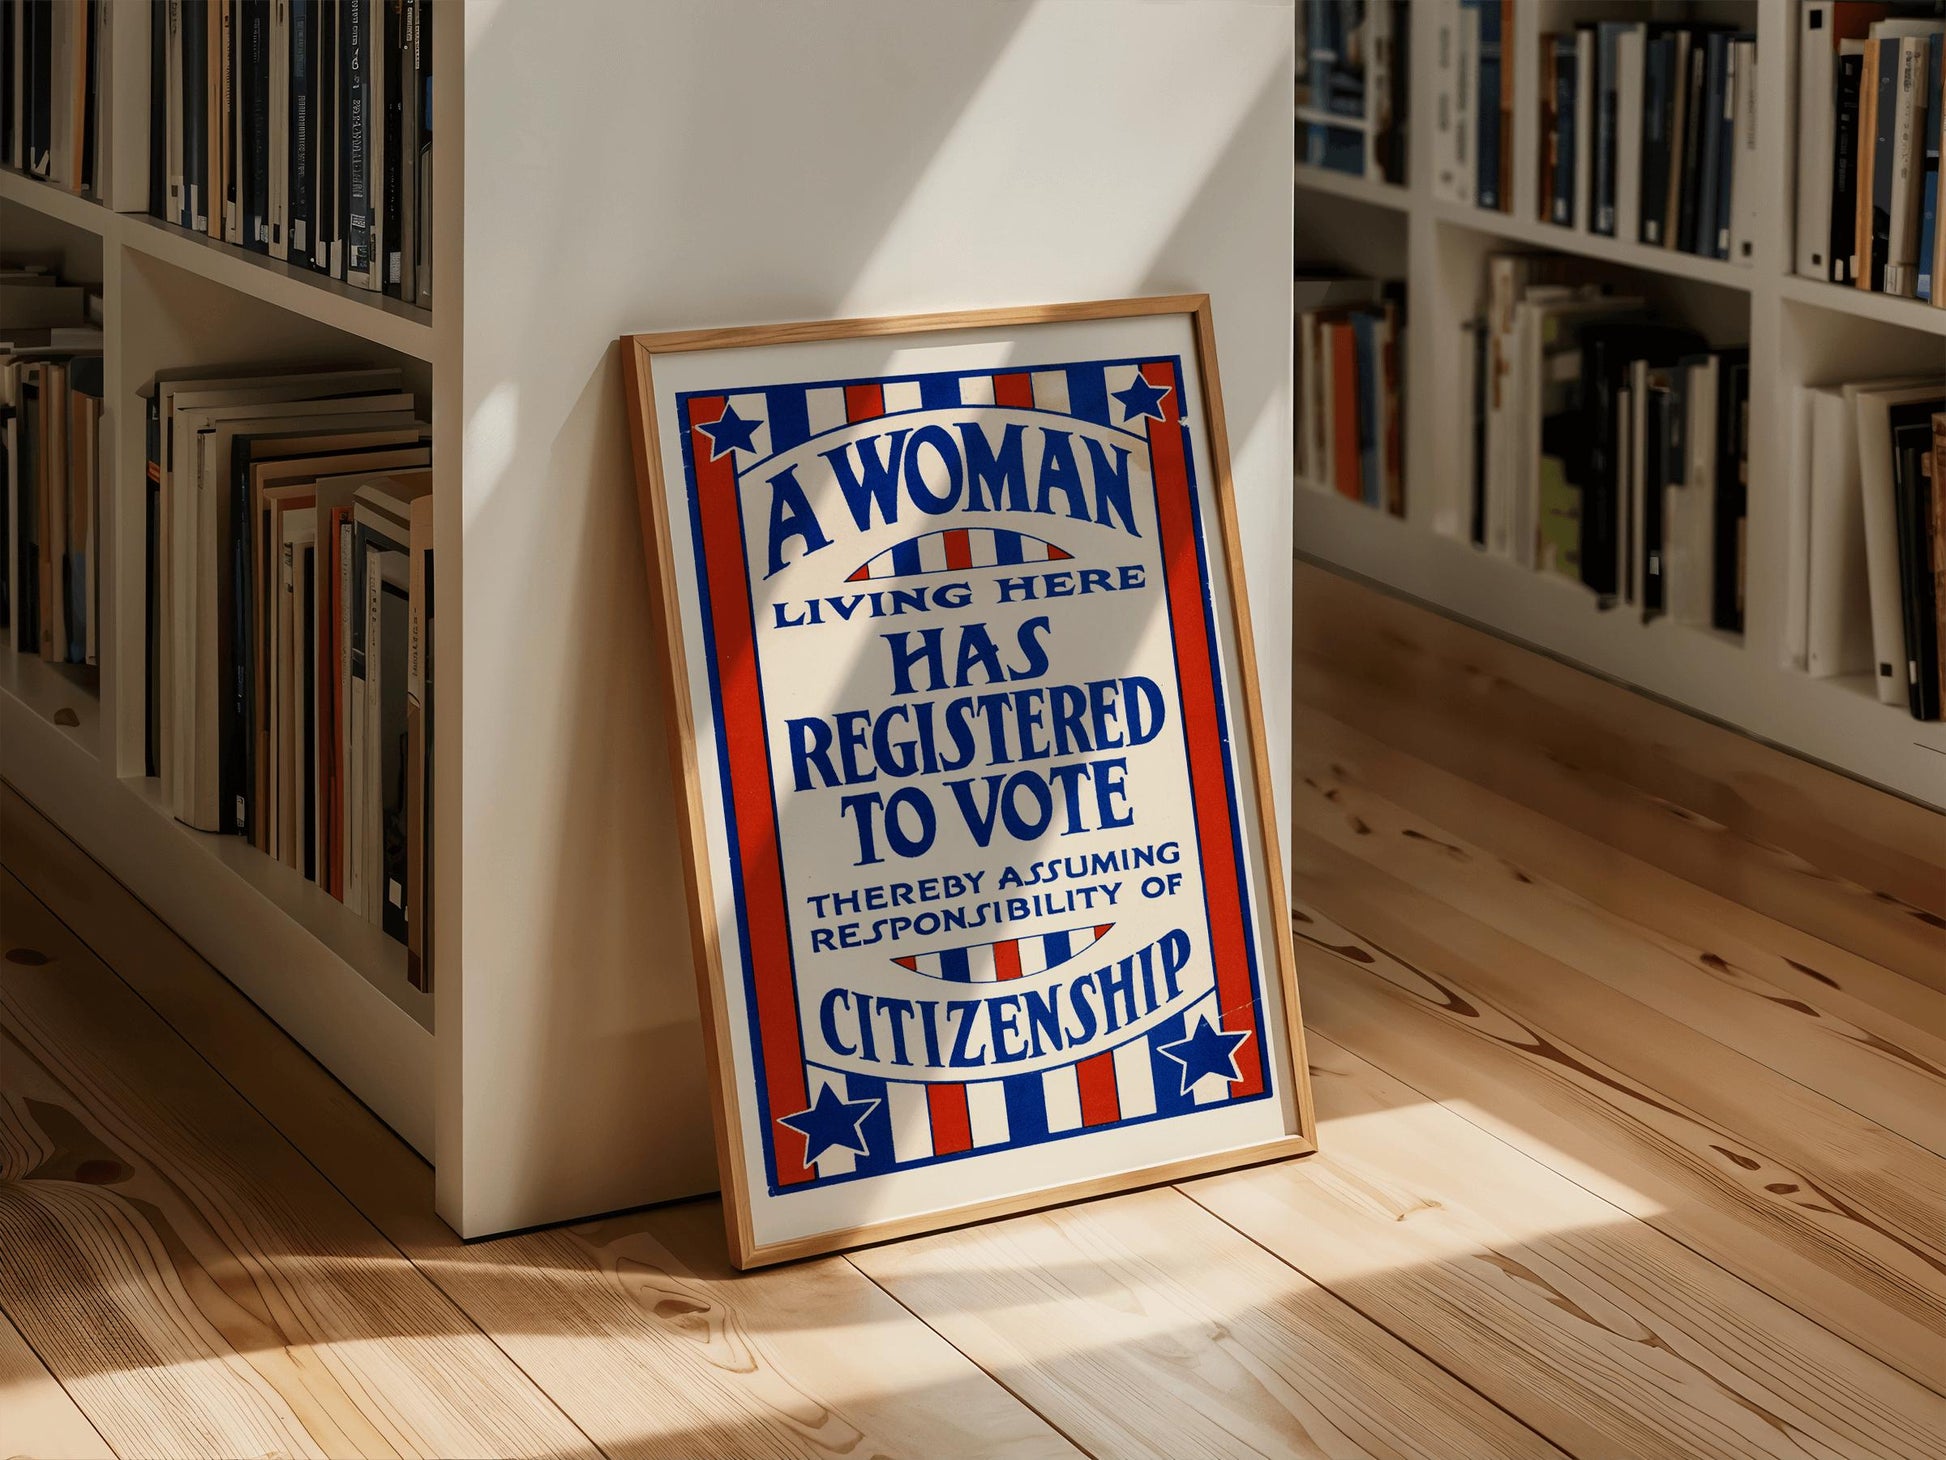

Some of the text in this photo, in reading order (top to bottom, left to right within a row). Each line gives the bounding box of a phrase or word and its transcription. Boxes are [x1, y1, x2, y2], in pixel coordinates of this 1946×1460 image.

[762, 422, 1142, 580] A WOMAN
[773, 564, 1146, 629] LIVING HERE
[880, 615, 1052, 696] HAS
[784, 675, 1166, 792] REGISTERED
[840, 756, 1135, 866] TO VOTE
[807, 841, 1181, 918] THEREBY ASSUMING
[810, 872, 1183, 953] RESPONSIBILITY OF
[818, 927, 1192, 1069] CITIZENSHIP
